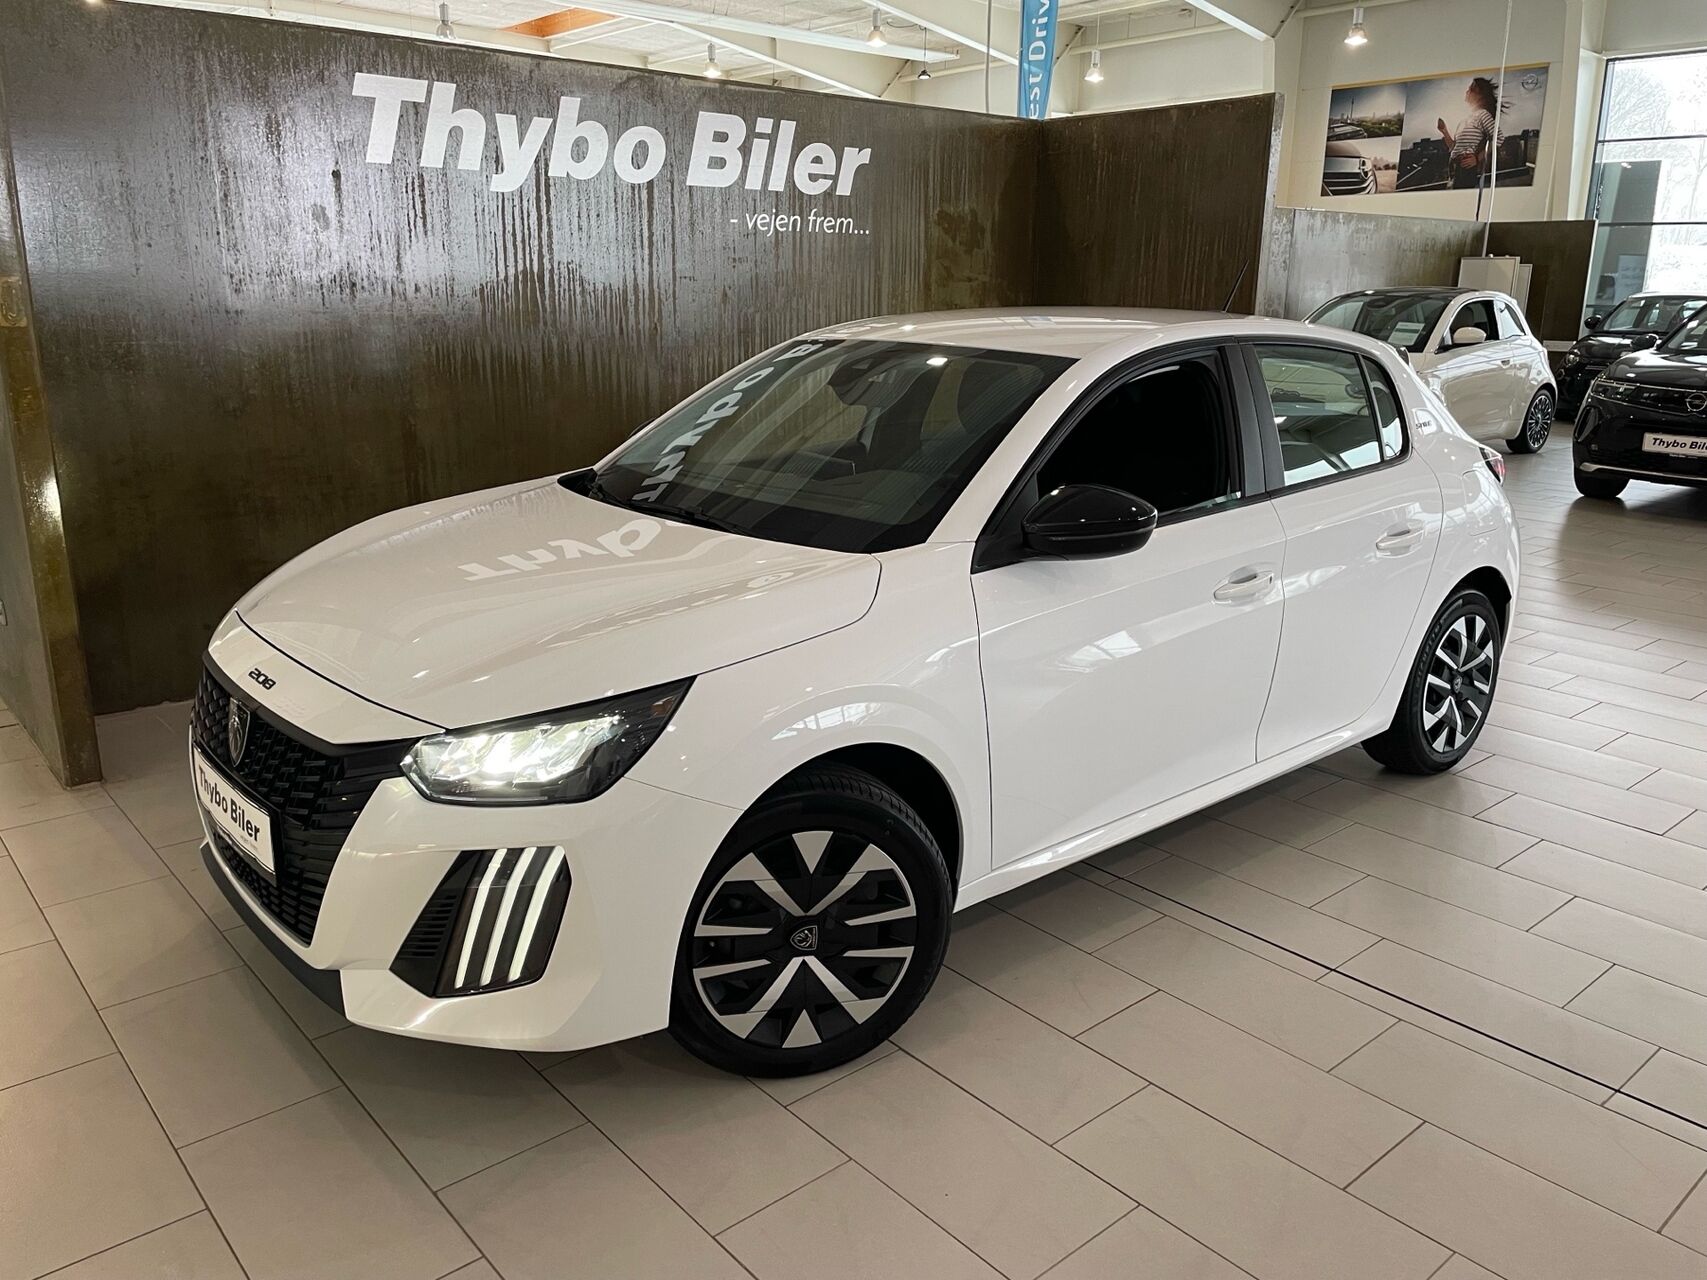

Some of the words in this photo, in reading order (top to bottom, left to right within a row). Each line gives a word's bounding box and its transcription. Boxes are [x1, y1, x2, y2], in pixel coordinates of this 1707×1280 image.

[352, 72, 667, 193] Thybo
[686, 111, 872, 196] Biler
[745, 208, 801, 237] vejen
[808, 208, 870, 235] frem...
[1652, 437, 1687, 448] Thybo
[1689, 441, 1707, 450] Bil
[248, 667, 277, 690] 208
[199, 764, 228, 813] Thybo
[230, 798, 260, 842] Biler
